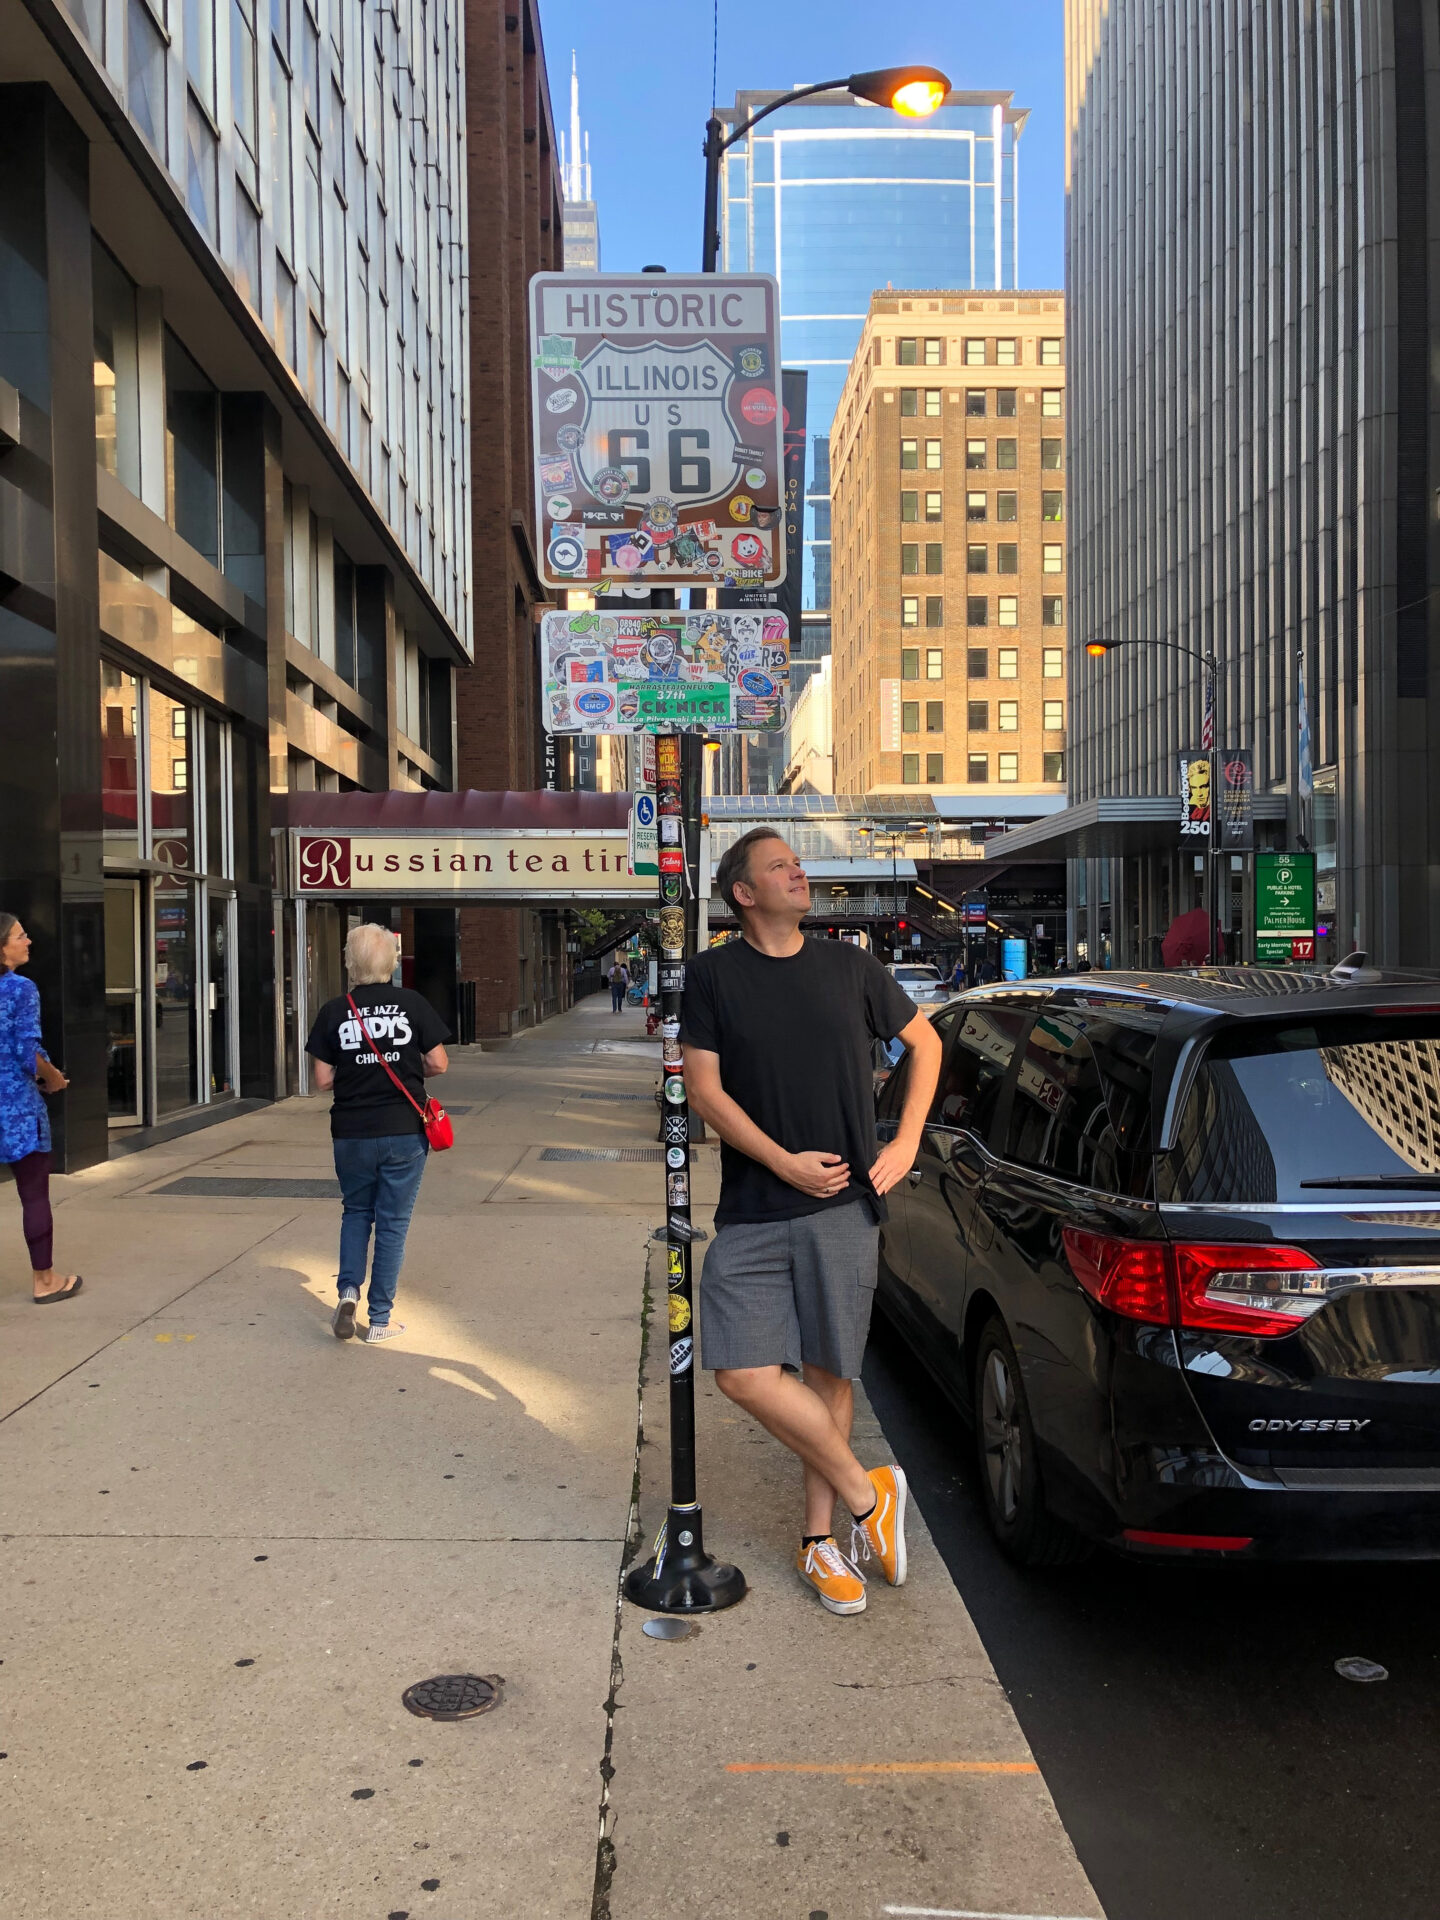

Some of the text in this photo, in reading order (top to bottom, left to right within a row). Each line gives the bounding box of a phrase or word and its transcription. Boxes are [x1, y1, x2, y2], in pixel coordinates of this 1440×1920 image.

[566, 293, 743, 327] HISTORIC
[597, 365, 718, 390] ILLINOIS
[635, 404, 682, 426] U S
[607, 428, 711, 494] 66
[742, 569, 763, 578] BIKE
[620, 627, 640, 637] KNY
[656, 690, 686, 700] 37th
[691, 715, 727, 723] 4.8.2019
[1180, 760, 1190, 820] Beethoven
[1180, 820, 1210, 835] 250
[301, 838, 493, 887] Russian
[507, 848, 570, 873] tea
[1279, 855, 1290, 864] 55
[347, 1004, 399, 1019] LVE JAZZ
[338, 1011, 413, 1050] ANDY'S
[355, 1051, 400, 1065] CHICGO
[1248, 1419, 1371, 1432] ODYSSEY
